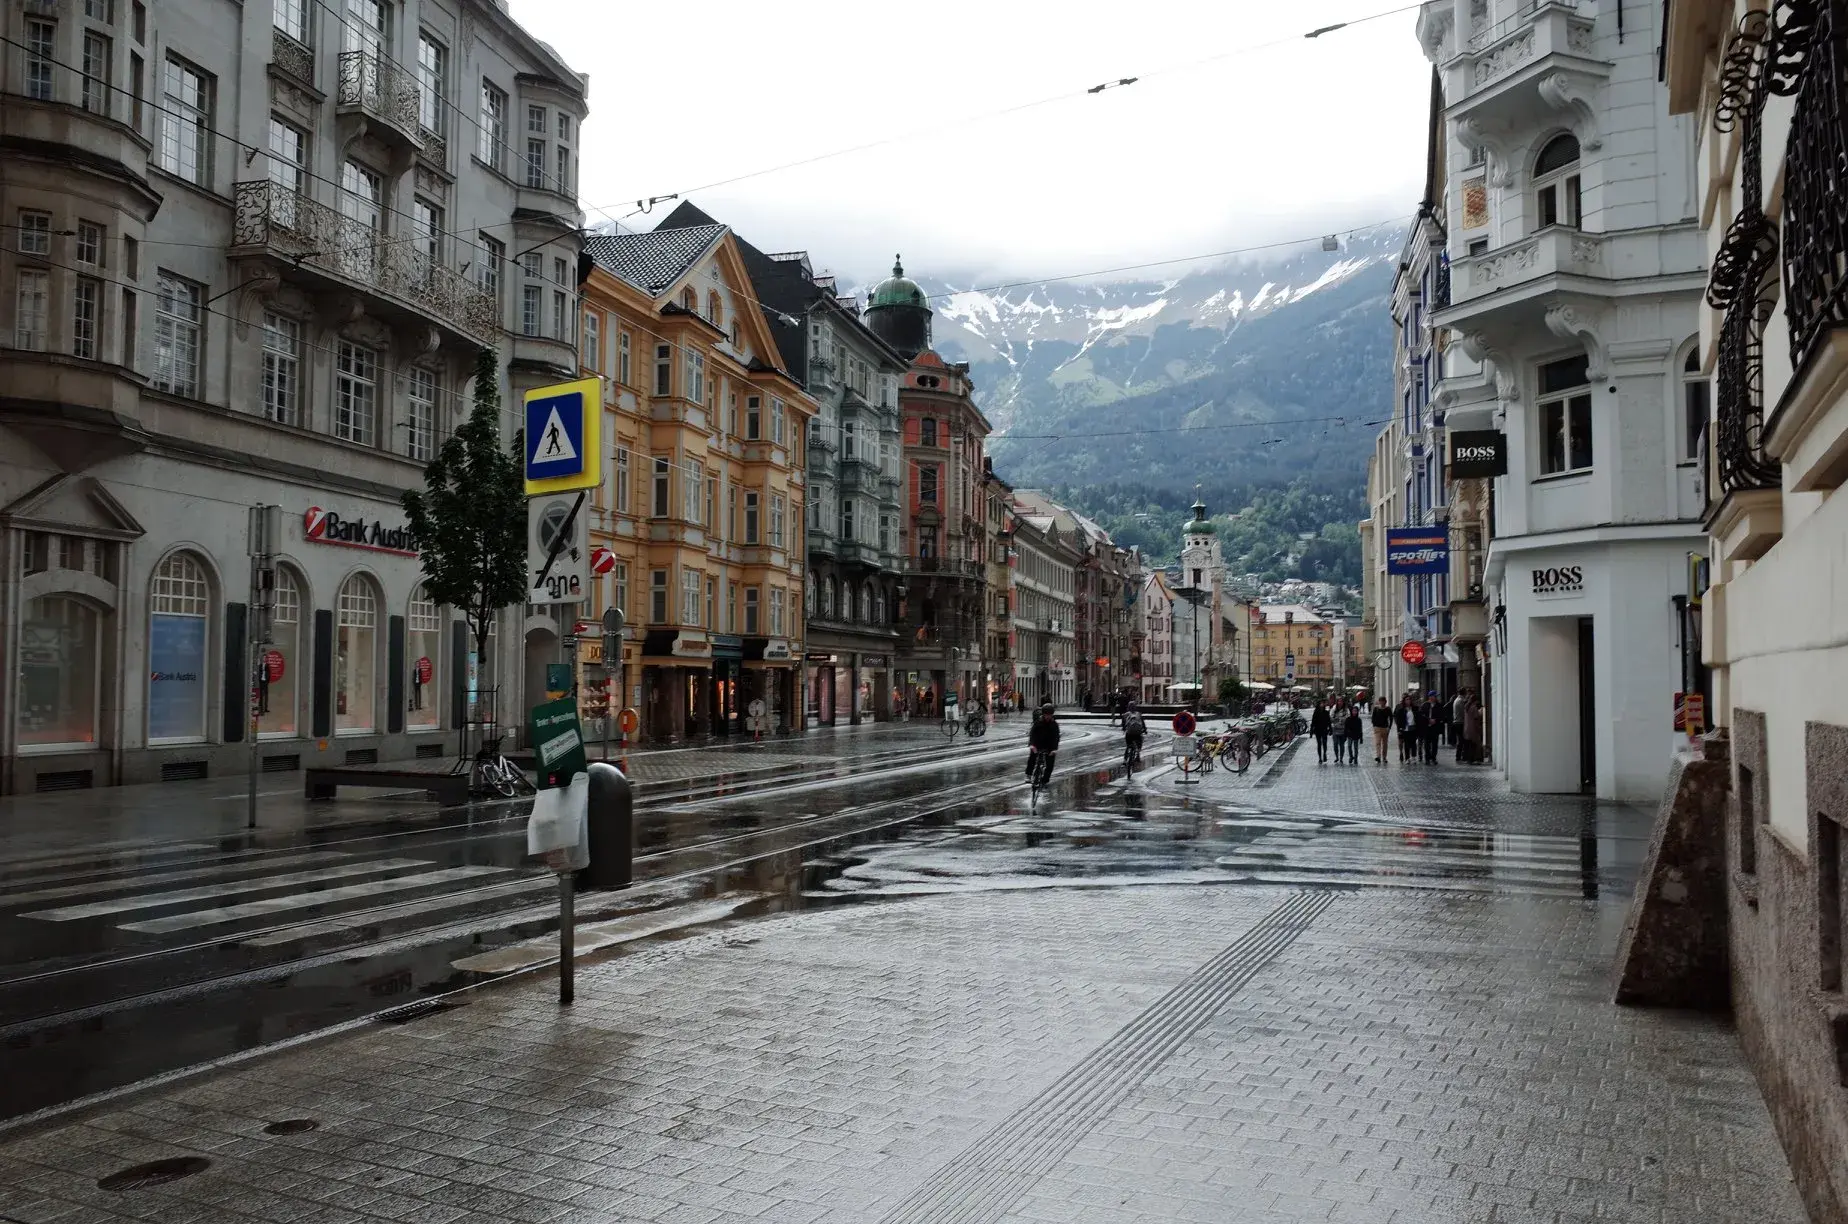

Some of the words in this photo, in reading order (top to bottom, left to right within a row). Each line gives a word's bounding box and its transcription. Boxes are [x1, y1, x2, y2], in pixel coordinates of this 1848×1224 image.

[1457, 446, 1496, 459] BOSS
[327, 512, 368, 544] Bank
[1389, 549, 1446, 562] SPORTLER
[1532, 566, 1582, 586] BOSS
